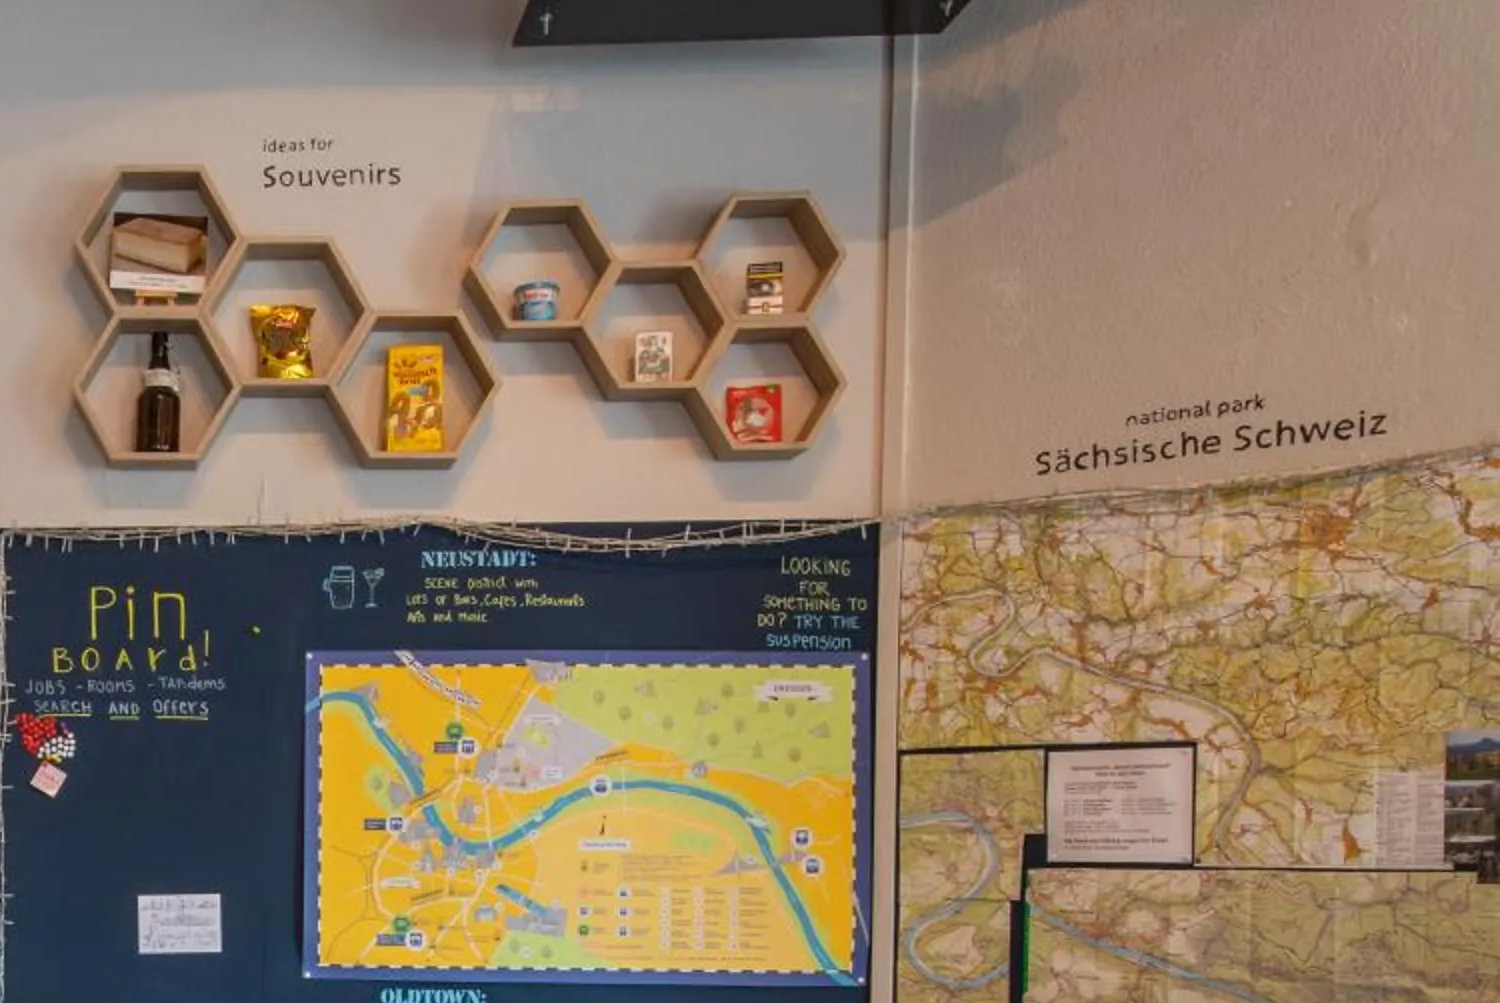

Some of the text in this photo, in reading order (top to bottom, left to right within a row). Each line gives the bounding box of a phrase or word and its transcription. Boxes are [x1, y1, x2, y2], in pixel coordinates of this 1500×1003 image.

[263, 138, 333, 152] ideas for
[263, 163, 402, 188] Souvenirs
[1125, 394, 1267, 427] national park
[1034, 410, 1388, 476] Sächsische Schweiz
[421, 550, 537, 569] NEUSTADT:
[781, 555, 852, 576] LOOKING
[799, 580, 831, 597] FOR
[763, 594, 869, 612] SOMETHING TO
[90, 585, 188, 641] Pin
[793, 614, 824, 629] TRY
[830, 615, 860, 629] THE
[25, 679, 66, 695] JOBS
[87, 679, 136, 693] ROOMS
[108, 701, 140, 716] AND
